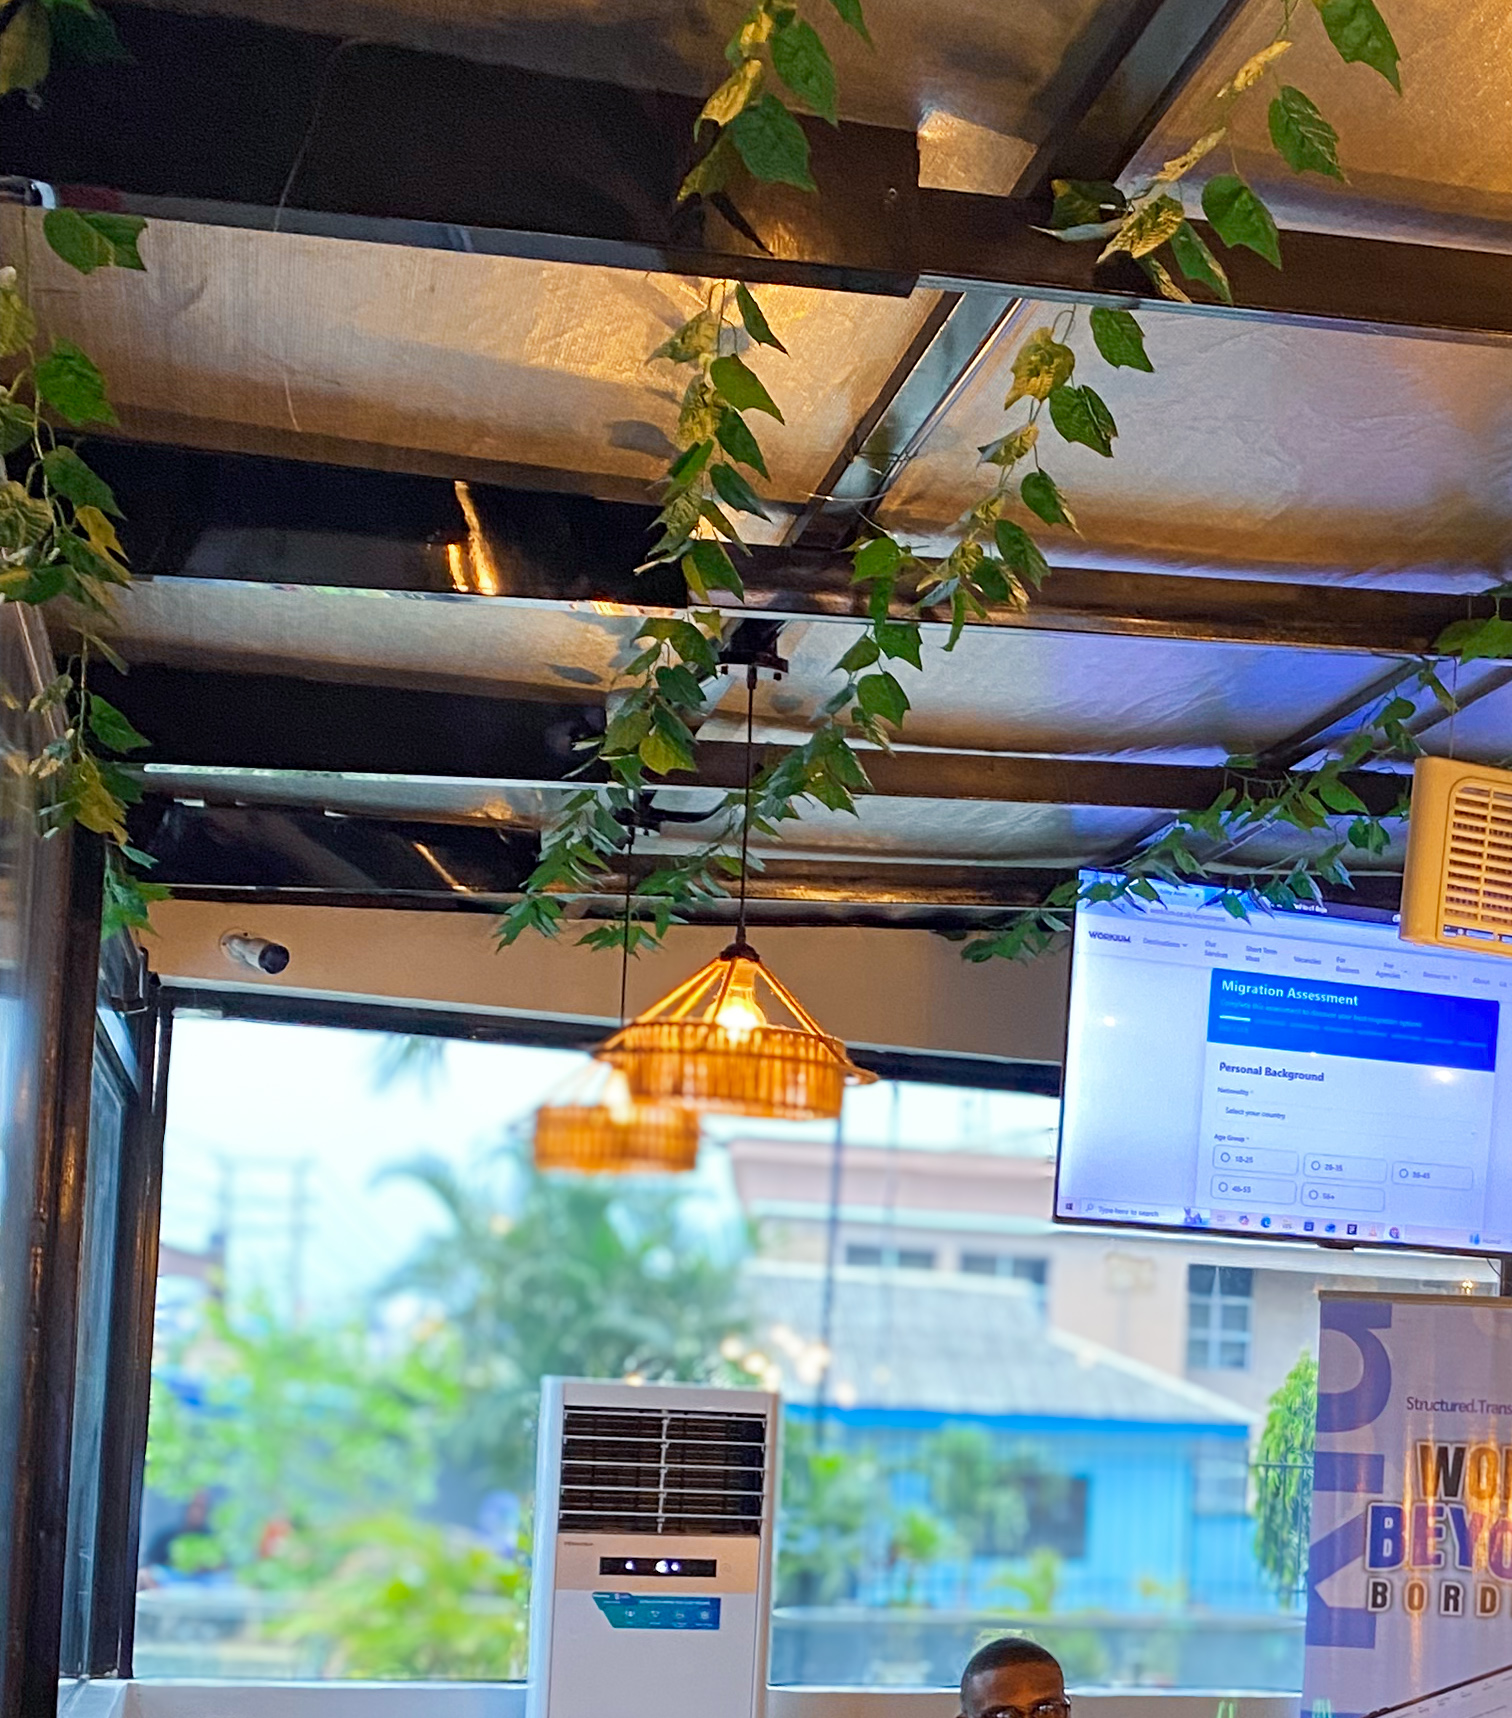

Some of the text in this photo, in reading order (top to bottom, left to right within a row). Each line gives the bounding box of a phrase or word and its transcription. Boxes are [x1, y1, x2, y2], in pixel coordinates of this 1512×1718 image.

[1089, 930, 1131, 943] WORKIUM
[1221, 979, 1359, 1006] Migration Assessment
[1219, 1061, 1325, 1082] Personal Background
[1261, 1111, 1286, 1120] country
[1214, 1133, 1226, 1142] Age
